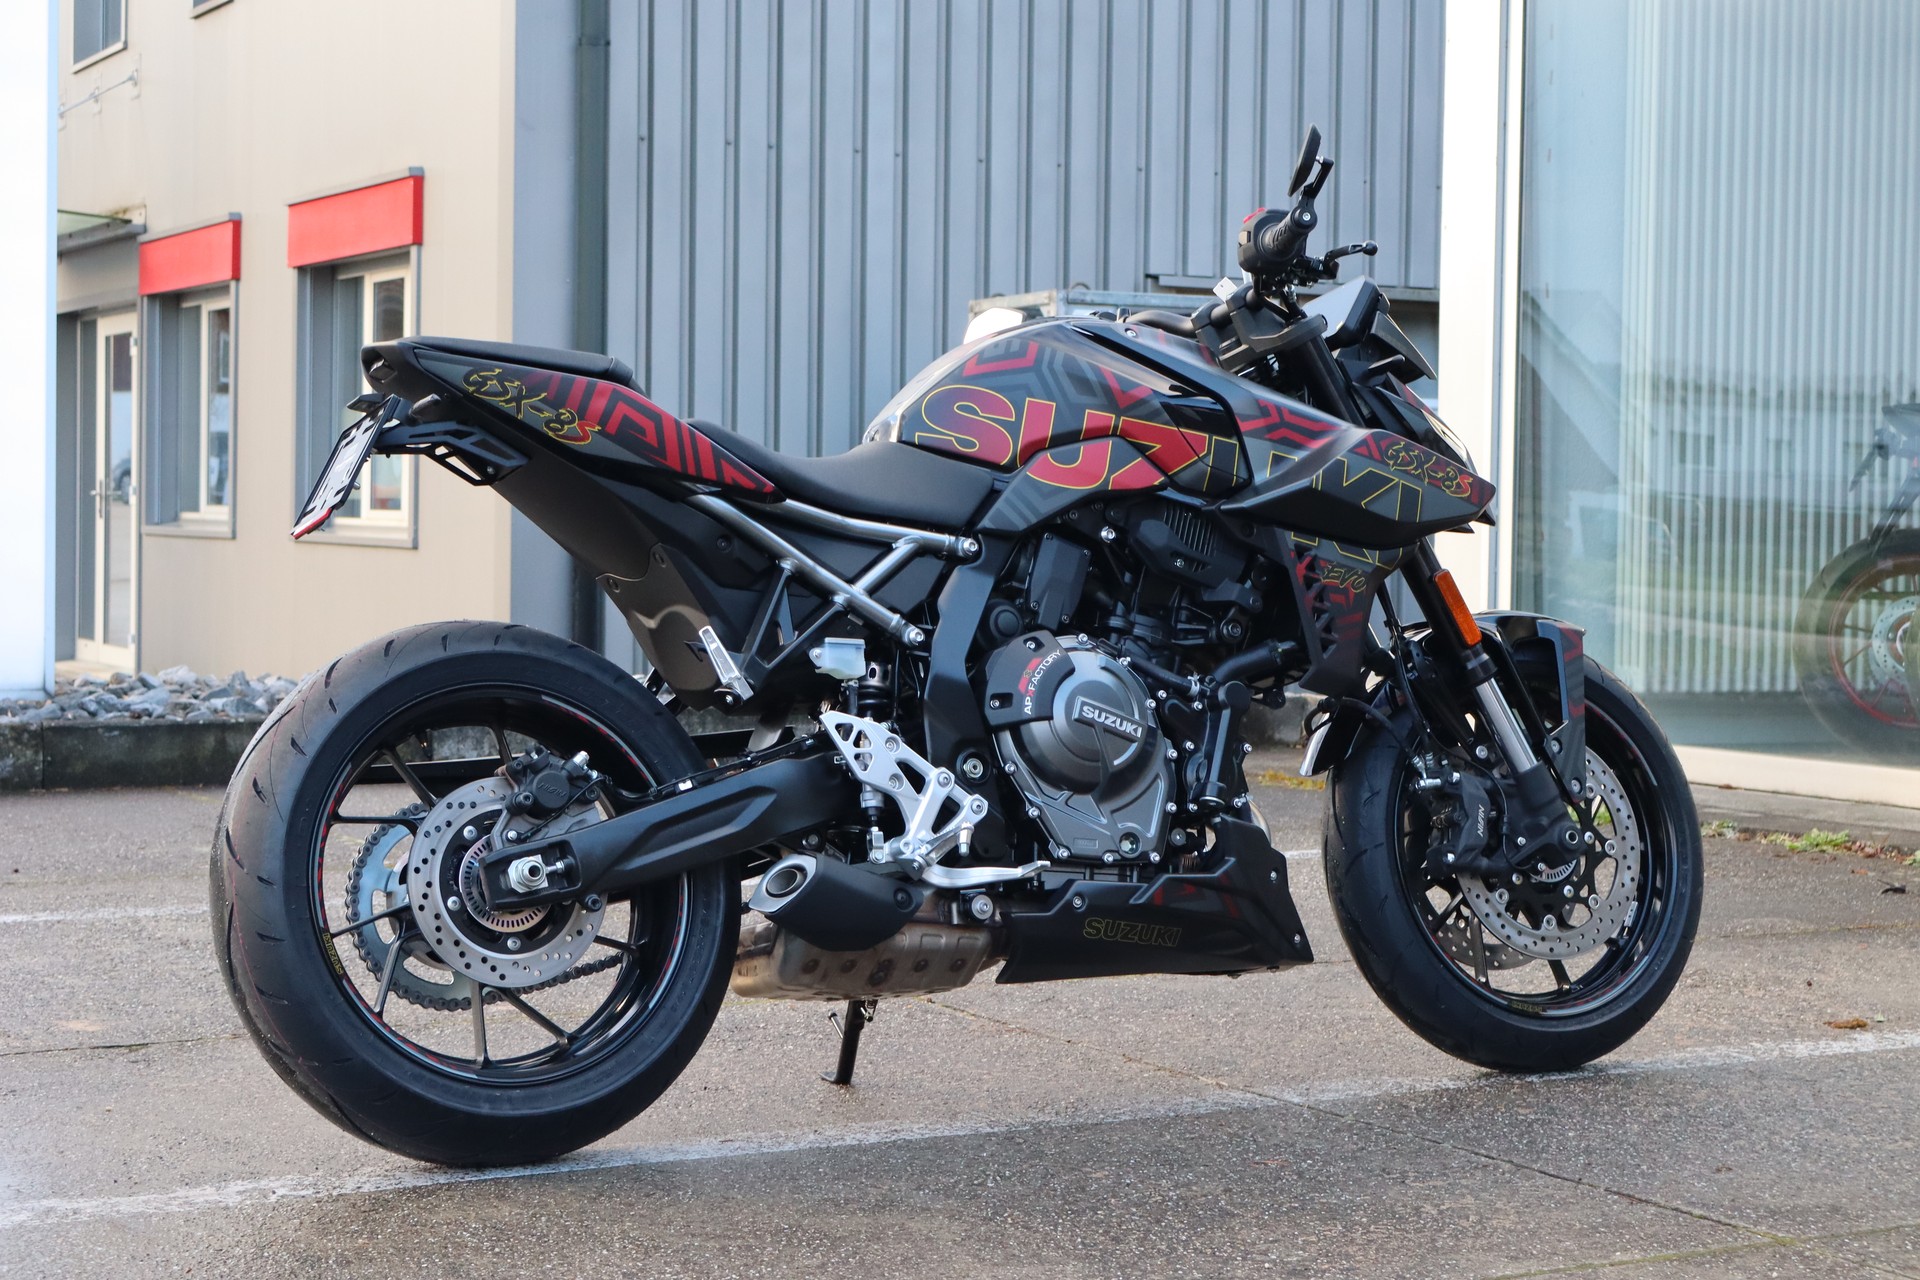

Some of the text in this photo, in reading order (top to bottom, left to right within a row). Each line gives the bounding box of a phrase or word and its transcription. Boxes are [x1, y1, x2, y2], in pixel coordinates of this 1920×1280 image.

[1081, 705, 1142, 738] SUZUKI
[1083, 917, 1182, 947] SUZUKI
[323, 932, 344, 975] SUZUKI
